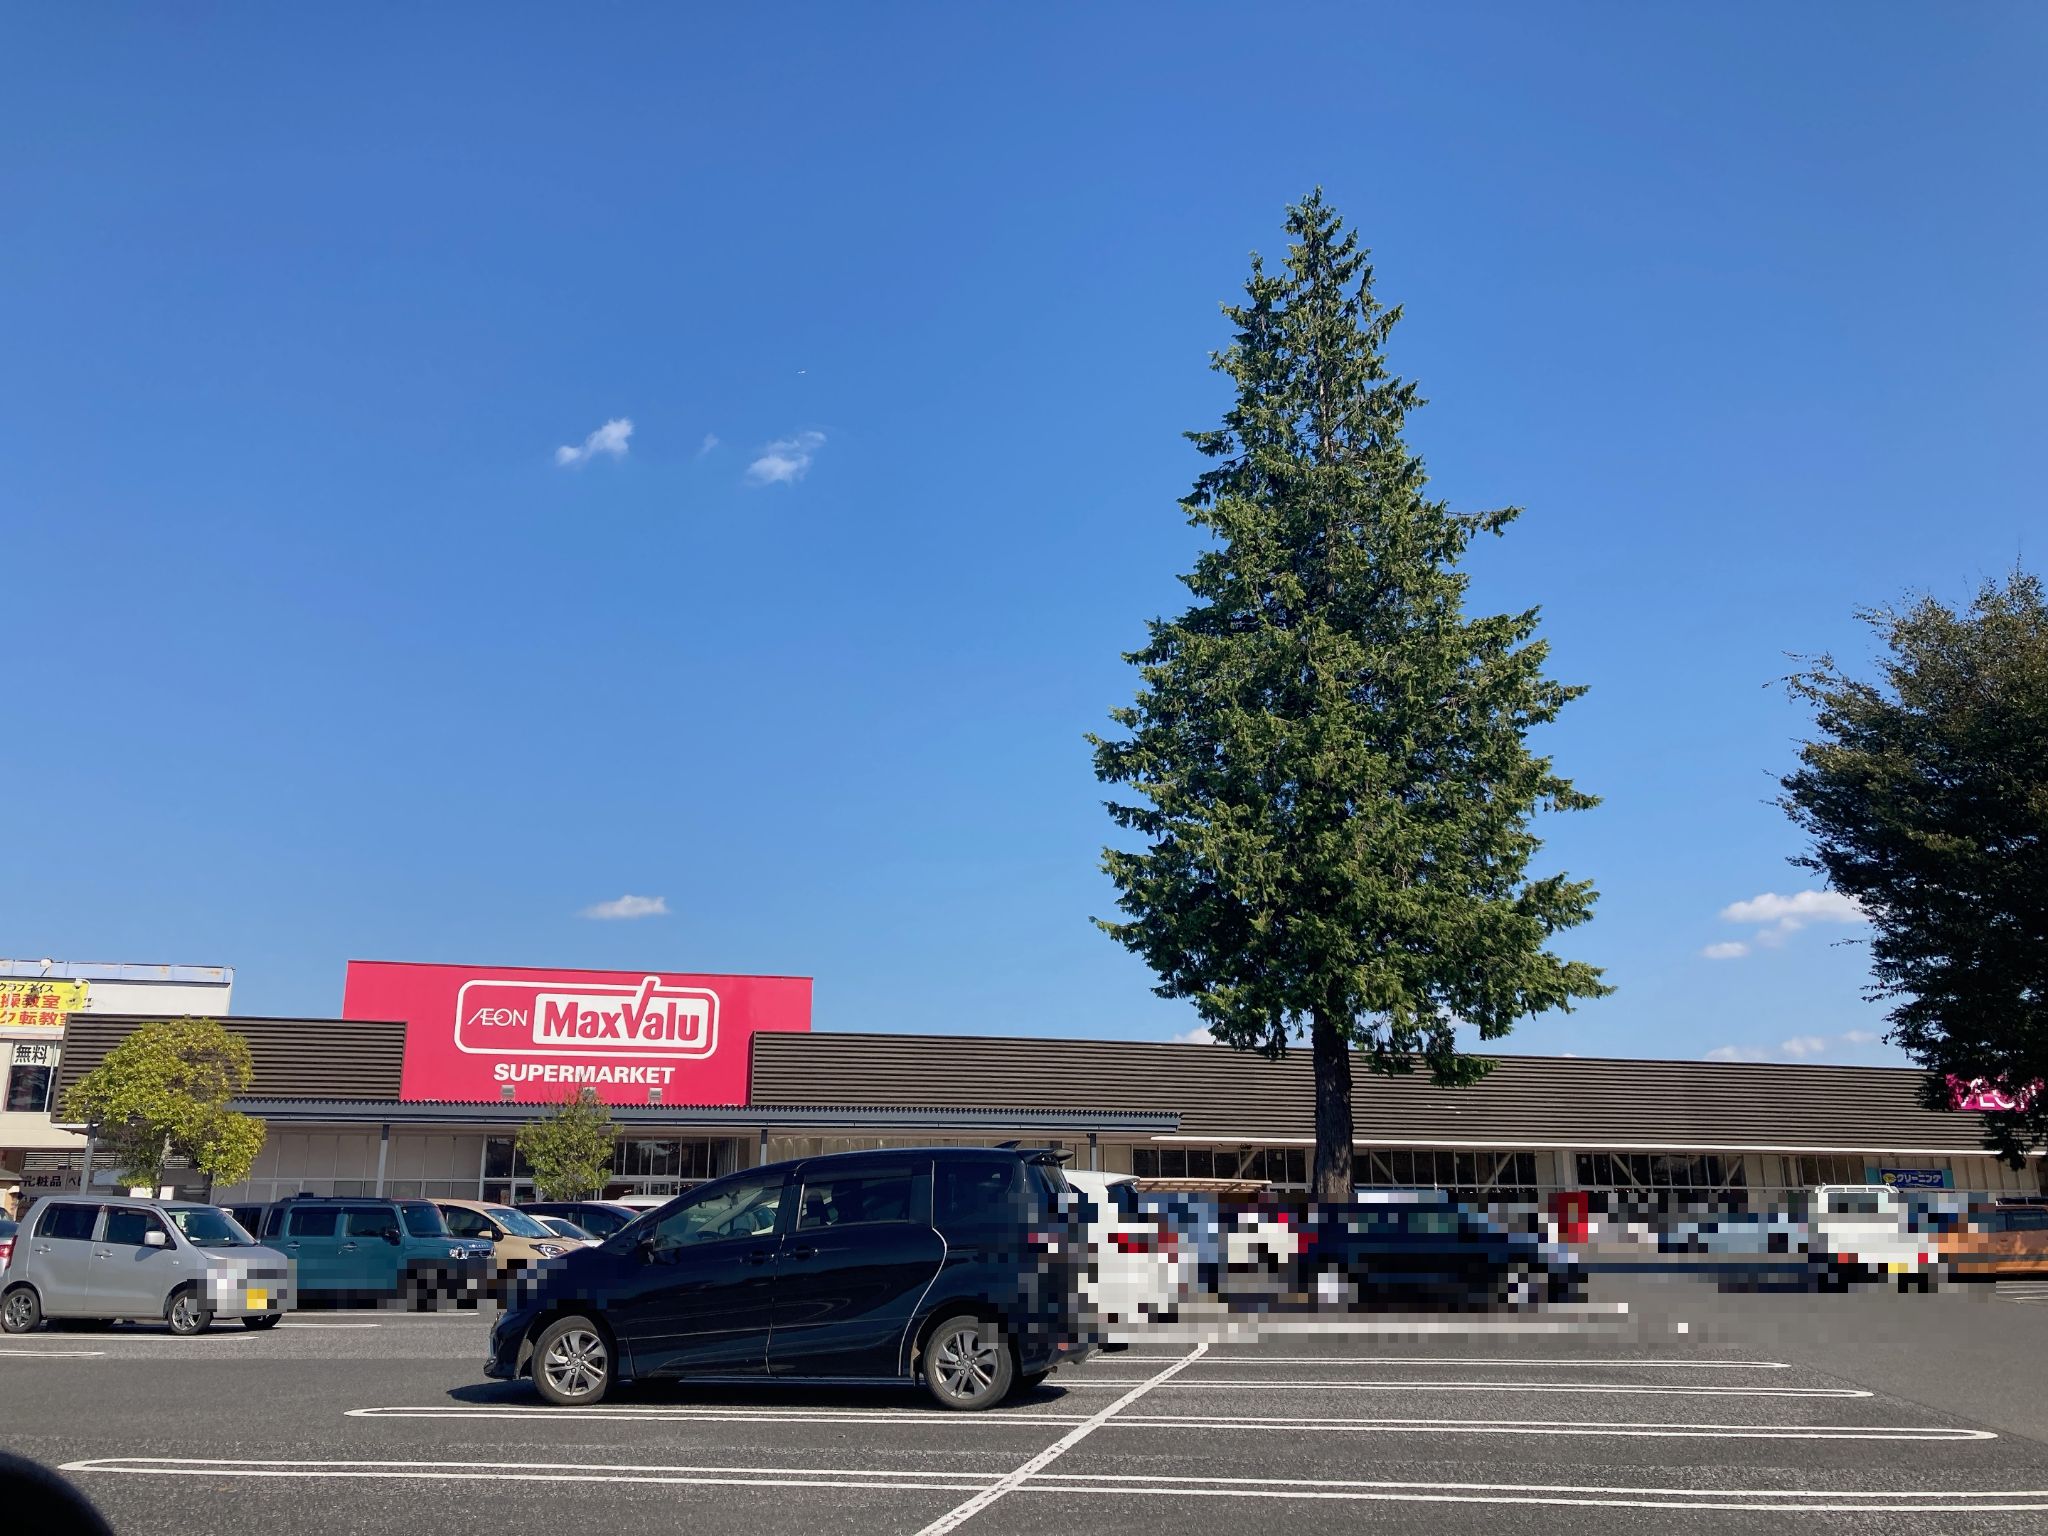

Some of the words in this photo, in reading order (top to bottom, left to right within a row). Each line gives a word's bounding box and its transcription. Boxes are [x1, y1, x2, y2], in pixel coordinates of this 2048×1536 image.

[543, 981, 699, 1042] MaxValu
[15, 1045, 48, 1064] 無料
[493, 1063, 675, 1085] SUPERMARKET
[1897, 1173, 1942, 1183] クリーニング
